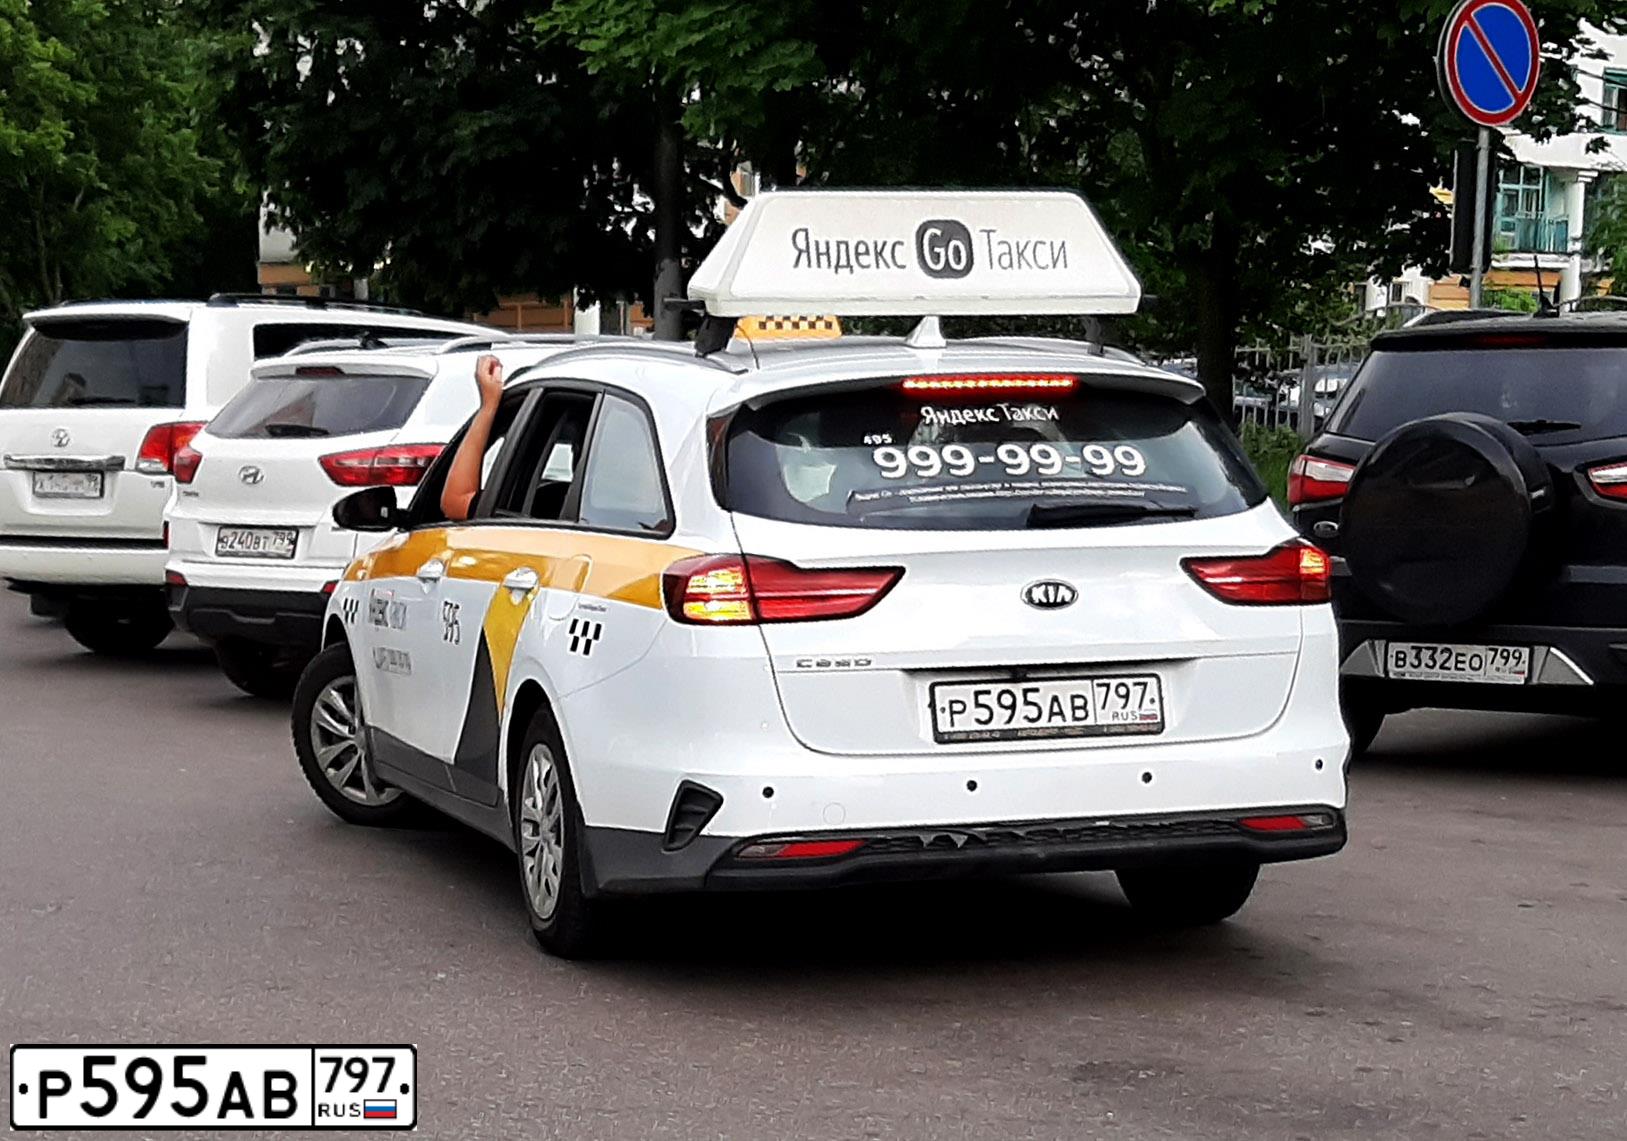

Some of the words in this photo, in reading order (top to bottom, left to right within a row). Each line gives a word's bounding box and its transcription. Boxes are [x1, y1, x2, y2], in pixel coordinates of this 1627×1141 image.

[791, 227, 907, 275] Яндекс
[921, 228, 969, 271] Go
[979, 229, 1068, 271] Такси
[920, 406, 1000, 426] Яндекс
[997, 403, 1060, 421] Такси
[873, 444, 1146, 478] 999-99-99
[1031, 584, 1073, 603] KIA
[1487, 647, 1523, 667] 799
[1095, 681, 1149, 711] 797
[1112, 710, 1138, 721] RUS
